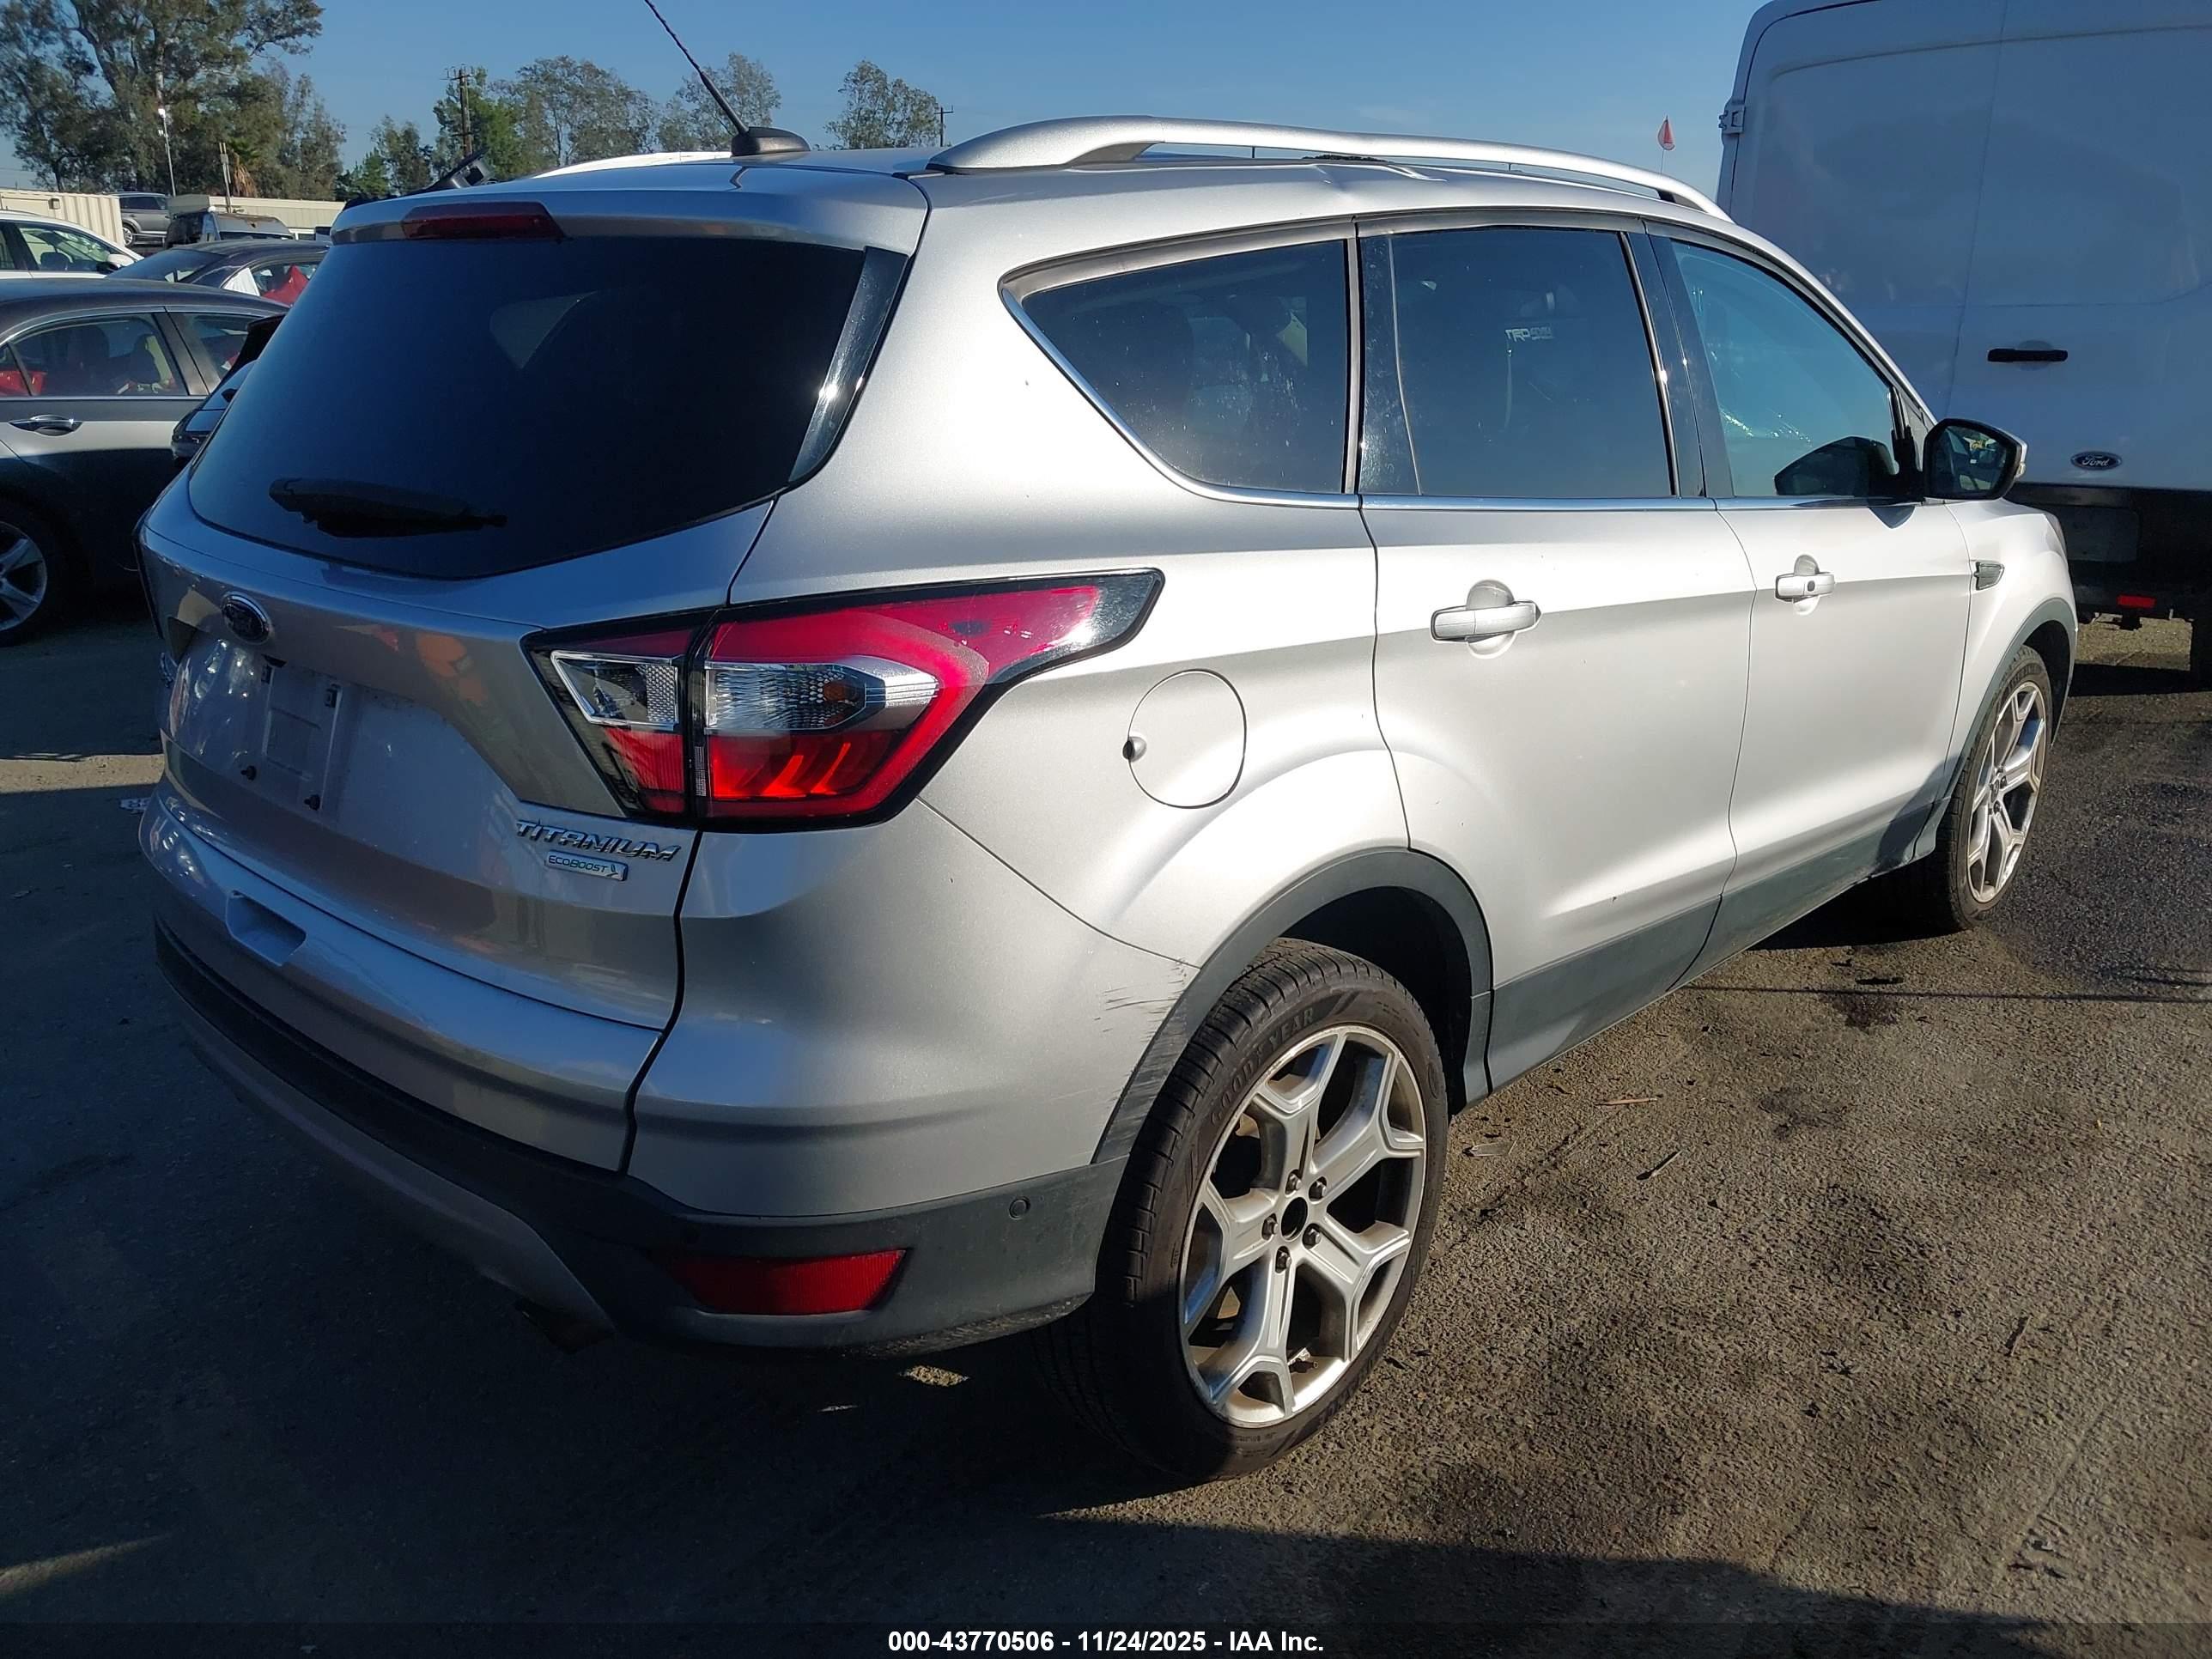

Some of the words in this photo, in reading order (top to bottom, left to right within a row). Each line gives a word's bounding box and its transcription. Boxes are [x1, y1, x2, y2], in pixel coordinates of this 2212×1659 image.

[2081, 455, 2111, 466] Ford
[516, 820, 681, 861] TITANIUM
[548, 855, 609, 873] ECOBOOST
